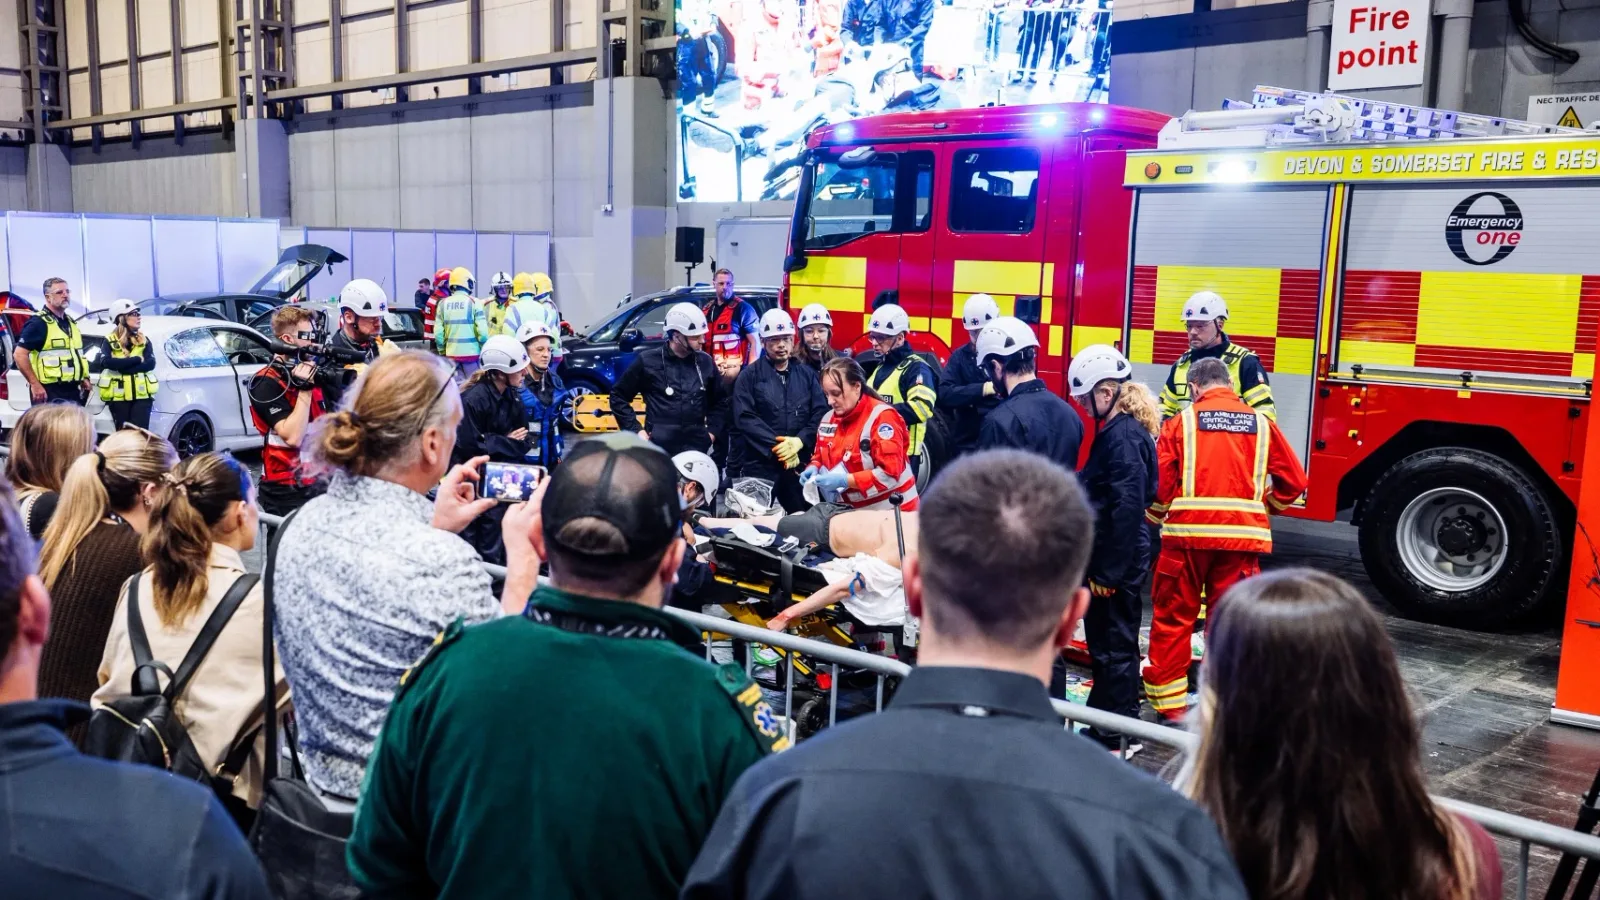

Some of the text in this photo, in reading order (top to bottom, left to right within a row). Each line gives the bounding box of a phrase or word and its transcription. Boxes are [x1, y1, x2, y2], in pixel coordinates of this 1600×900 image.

[1349, 6, 1410, 34] Fire
[1337, 40, 1419, 75] point
[1555, 95, 1587, 103] TRAFFIC
[1284, 149, 1600, 175] DEVON & SOMERSET FIRE & RES
[1446, 215, 1522, 230] Emergency
[1476, 231, 1522, 246] one
[446, 302, 465, 310] FIRE
[1214, 411, 1254, 420] AMBULANCE
[1207, 423, 1250, 432] PARAMEDIC
